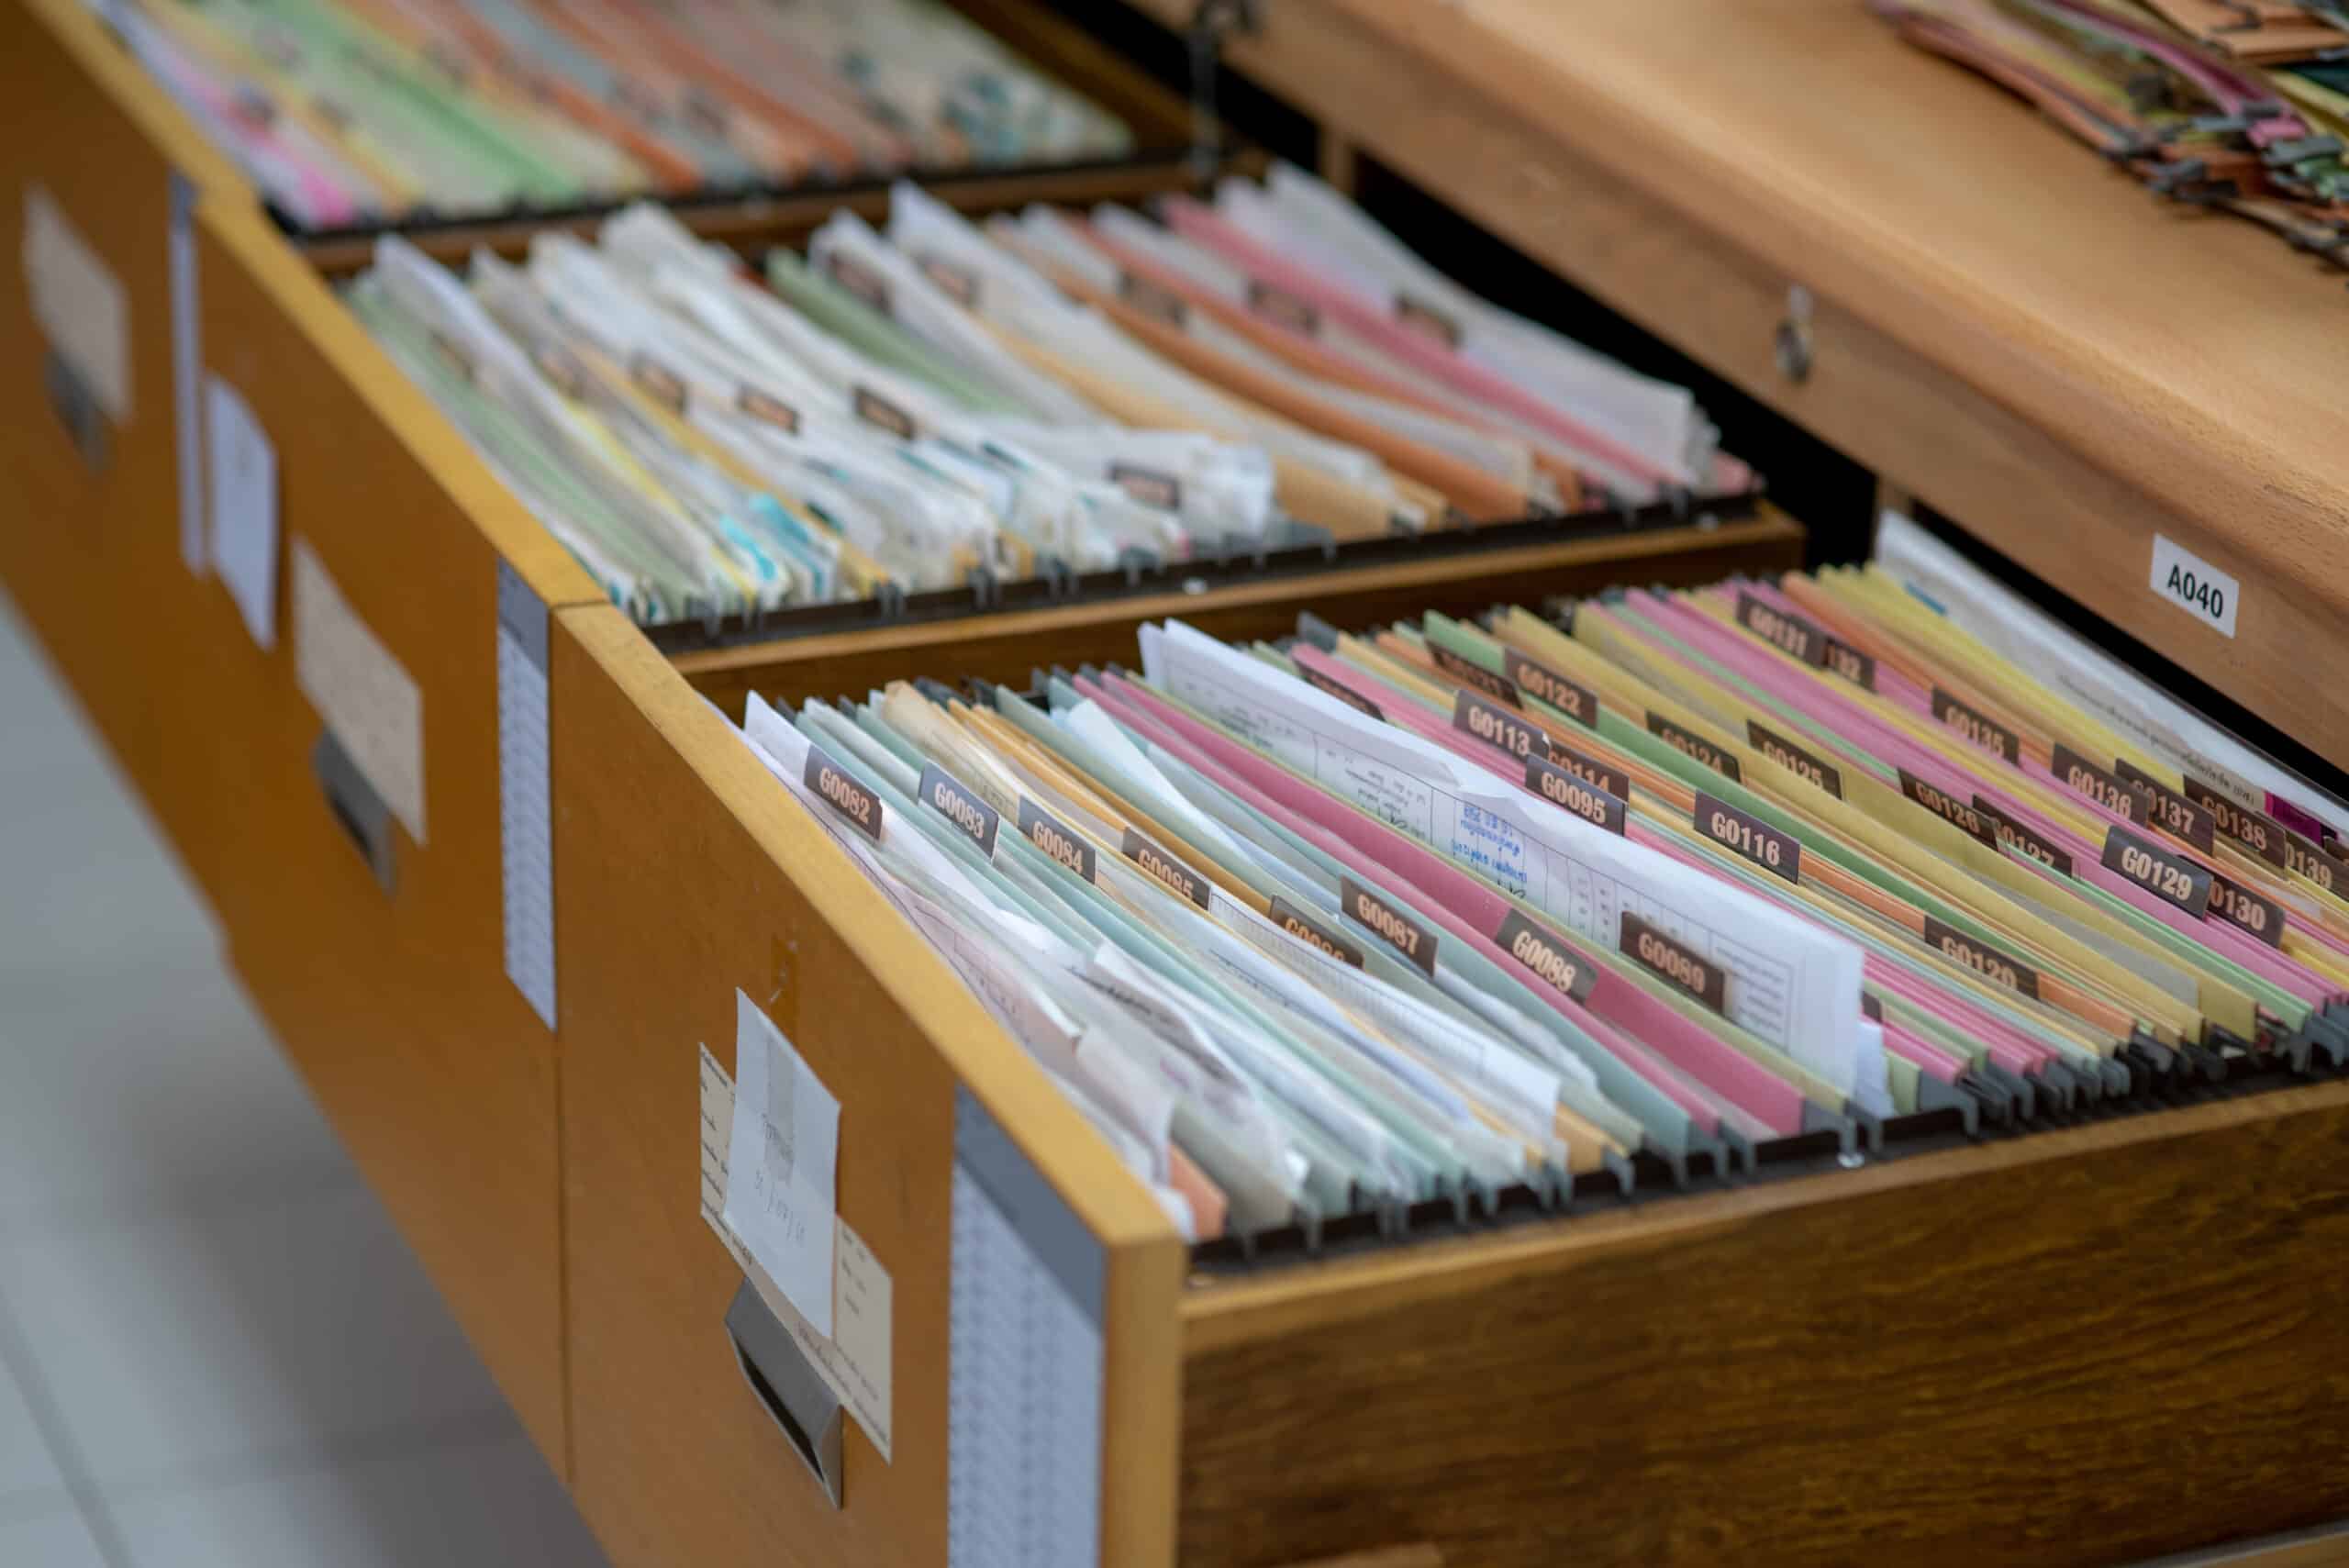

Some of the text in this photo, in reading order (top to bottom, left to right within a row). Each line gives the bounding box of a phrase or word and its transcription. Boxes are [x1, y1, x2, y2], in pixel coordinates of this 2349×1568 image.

[2167, 564, 2224, 619] A040
[1469, 706, 1530, 756] G0113
[818, 767, 871, 825] G0082
[934, 782, 985, 840] G0083
[1541, 772, 1606, 824] G0095
[1032, 821, 1084, 874] G0084
[1710, 811, 1781, 867] G0116
[2000, 821, 2055, 867] 0127
[2285, 841, 2333, 890] 0139
[2121, 845, 2193, 902] G0129
[1357, 893, 1419, 955] G0087
[2210, 881, 2266, 932] 0130
[1512, 929, 1576, 993] G0088
[1637, 932, 1706, 994] G0089
